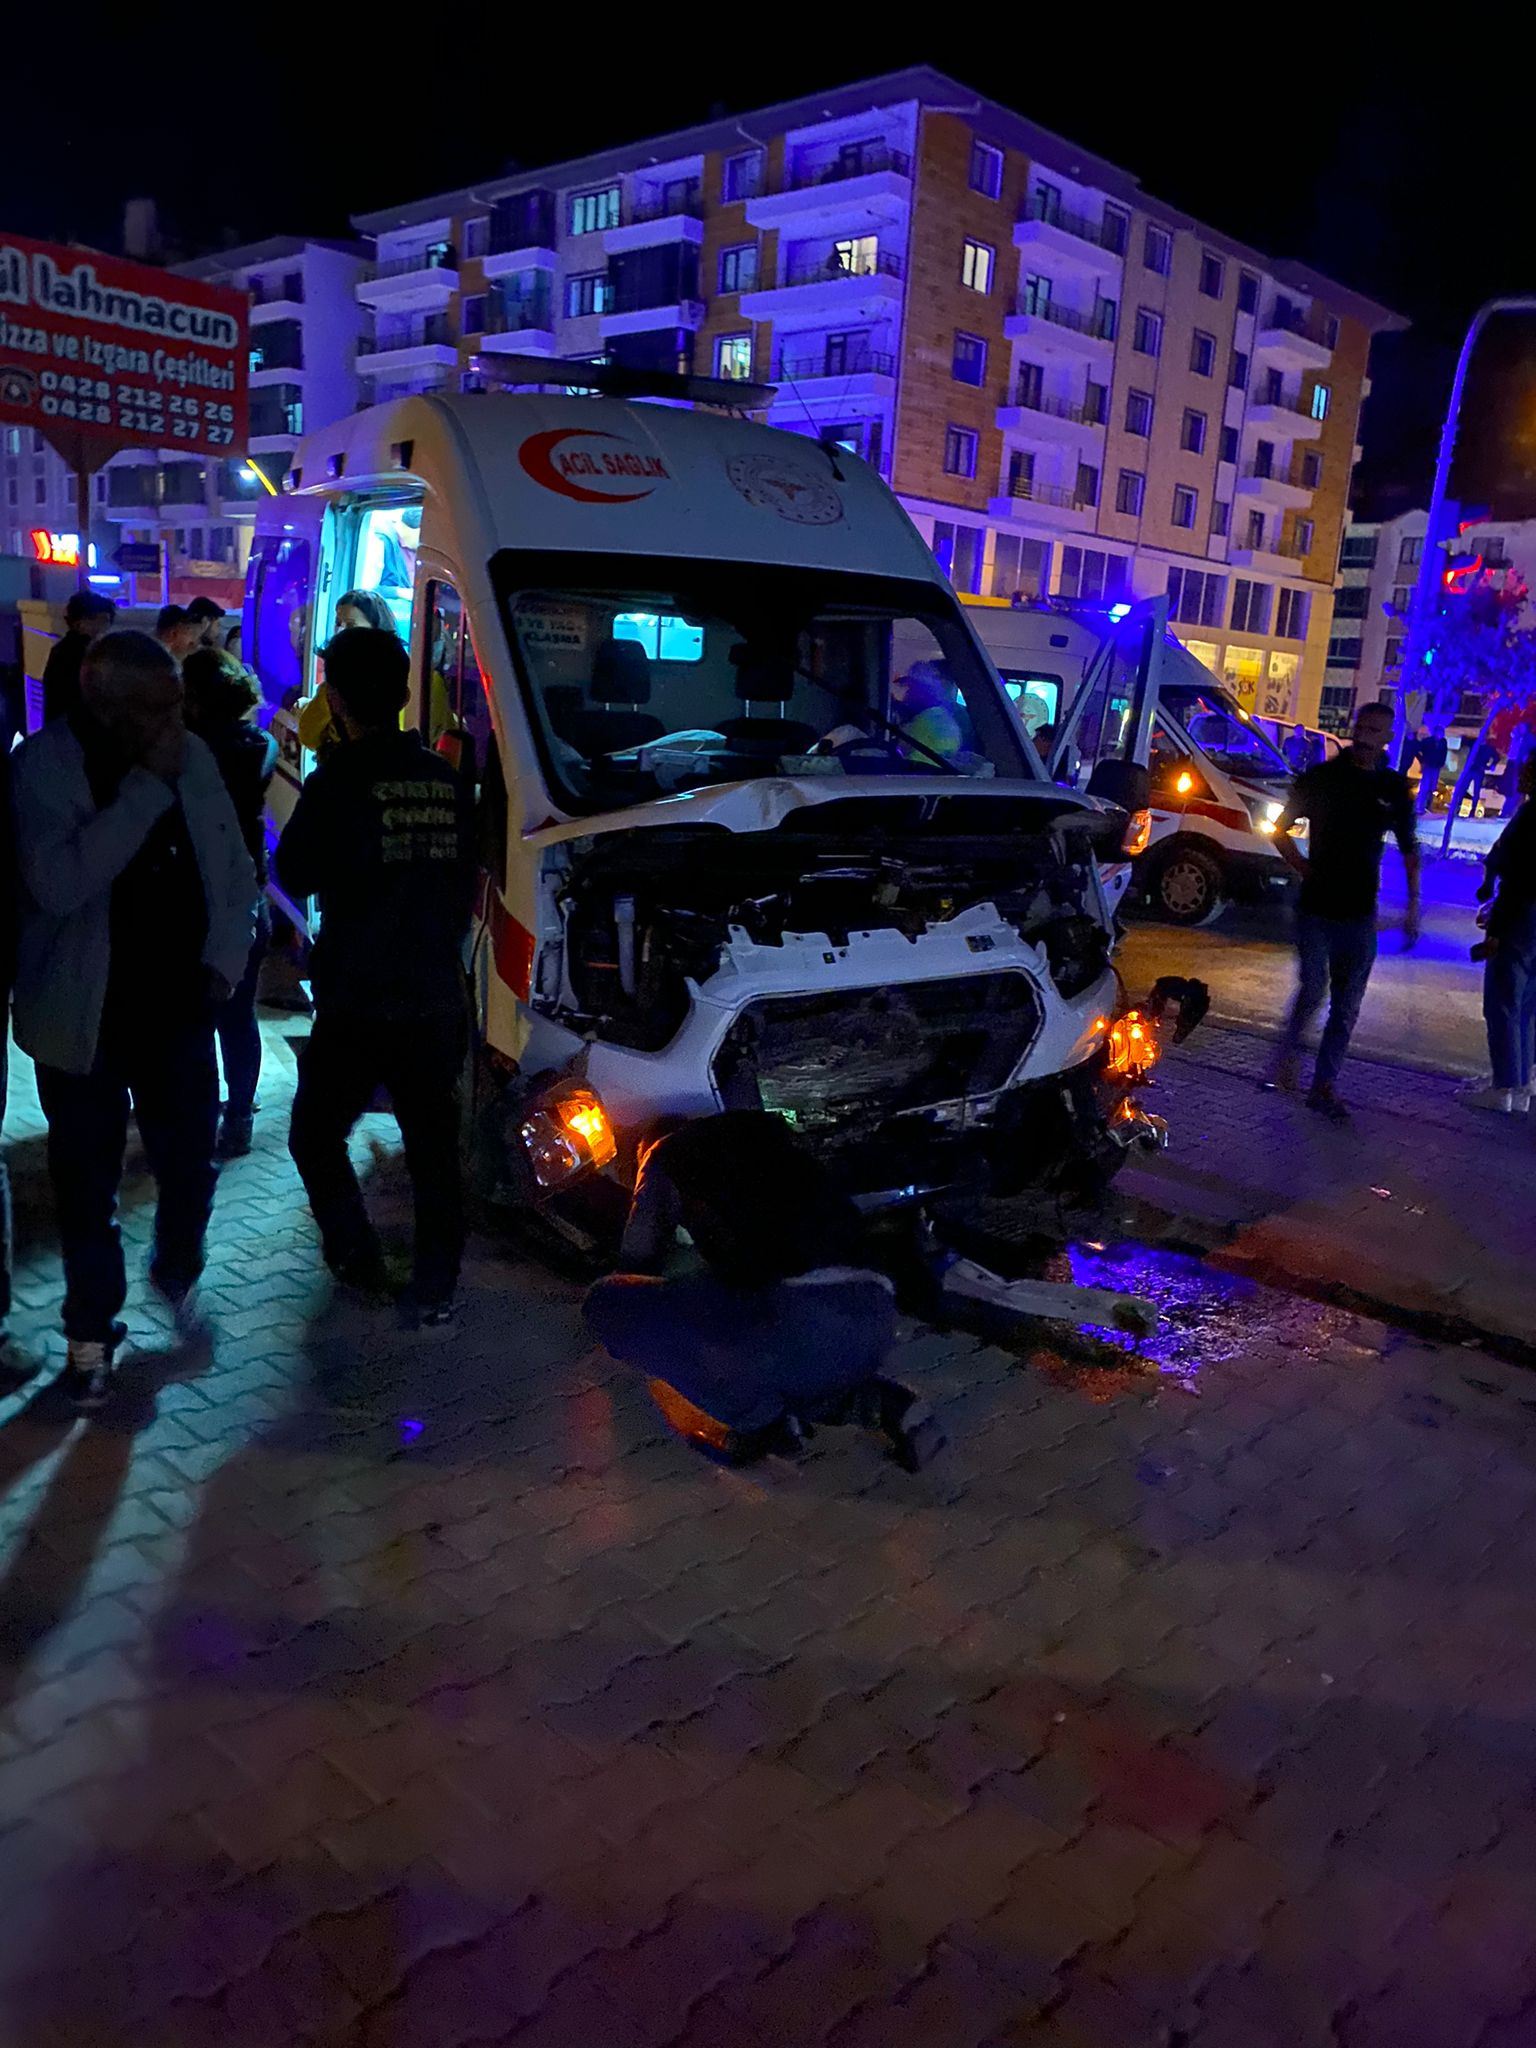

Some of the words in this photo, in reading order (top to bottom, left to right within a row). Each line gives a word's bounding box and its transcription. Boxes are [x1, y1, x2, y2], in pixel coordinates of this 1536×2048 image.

[37, 258, 235, 346] lahmacun
[52, 331, 80, 361] ve
[40, 370, 111, 401] 0428
[116, 384, 164, 411] 212
[168, 394, 199, 417] 26
[204, 400, 234, 424] 26
[41, 394, 112, 424] 0428
[119, 407, 165, 434] 212
[171, 417, 200, 440] 27
[207, 424, 235, 446] 27
